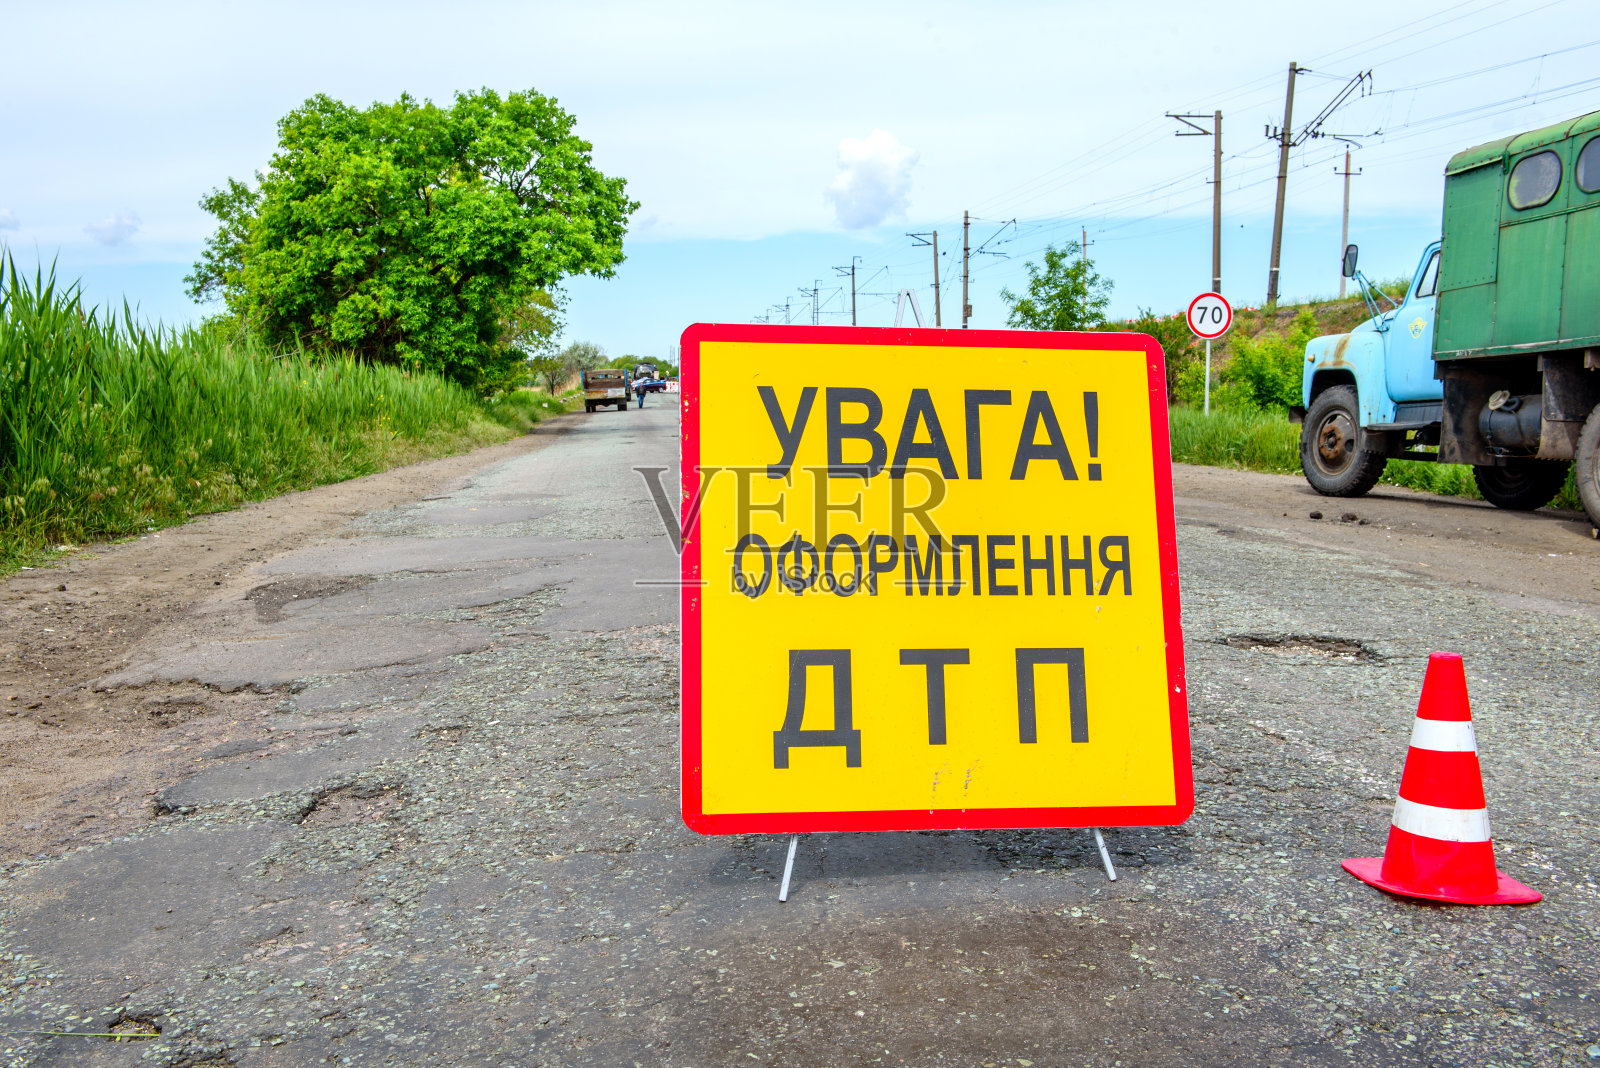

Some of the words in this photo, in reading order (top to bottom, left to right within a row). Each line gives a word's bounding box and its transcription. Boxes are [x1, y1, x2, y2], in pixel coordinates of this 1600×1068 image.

[1197, 306, 1223, 324] 70
[757, 386, 1101, 480] УВАГА!
[733, 533, 1131, 597] ОФОРМЛЕННЯ
[774, 648, 1089, 769] ДТП
